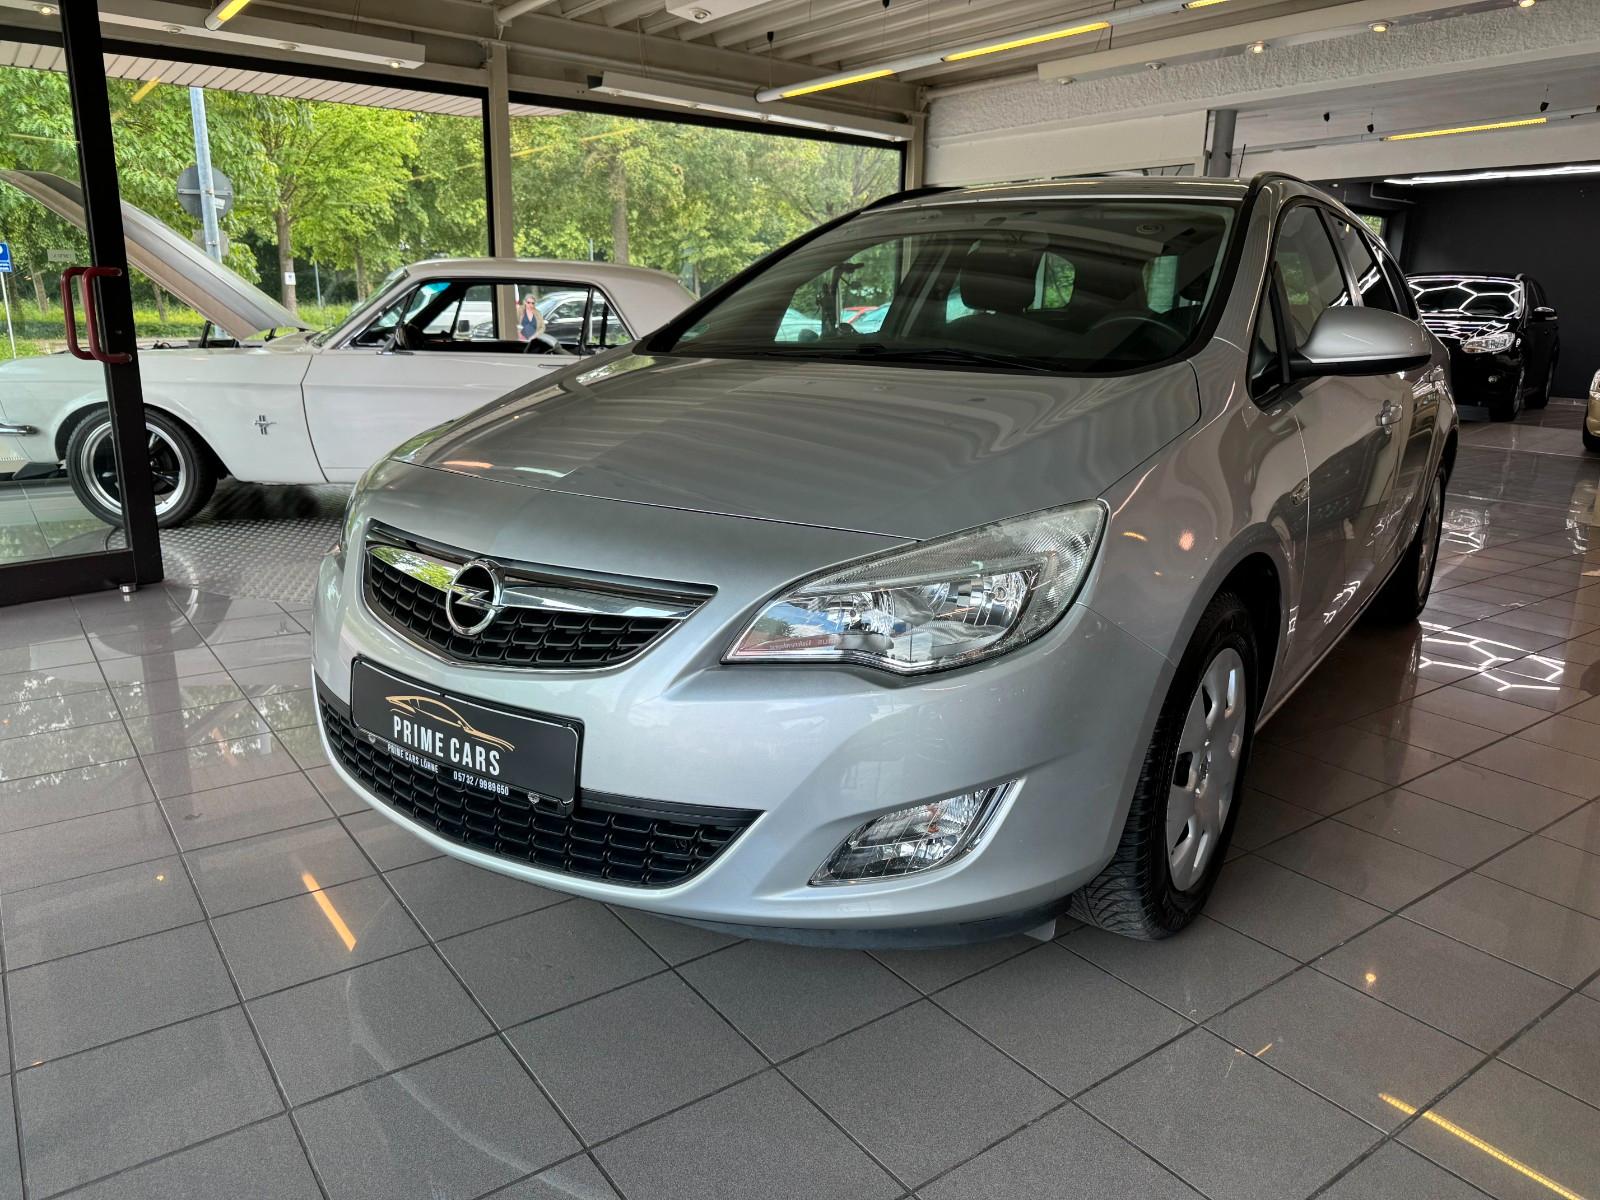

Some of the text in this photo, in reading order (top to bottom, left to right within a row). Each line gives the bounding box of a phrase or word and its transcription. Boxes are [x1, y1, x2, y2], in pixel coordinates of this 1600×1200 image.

[387, 743, 439, 773] PRIME CARS LÖHNE
[394, 715, 500, 776] PRIME CARS
